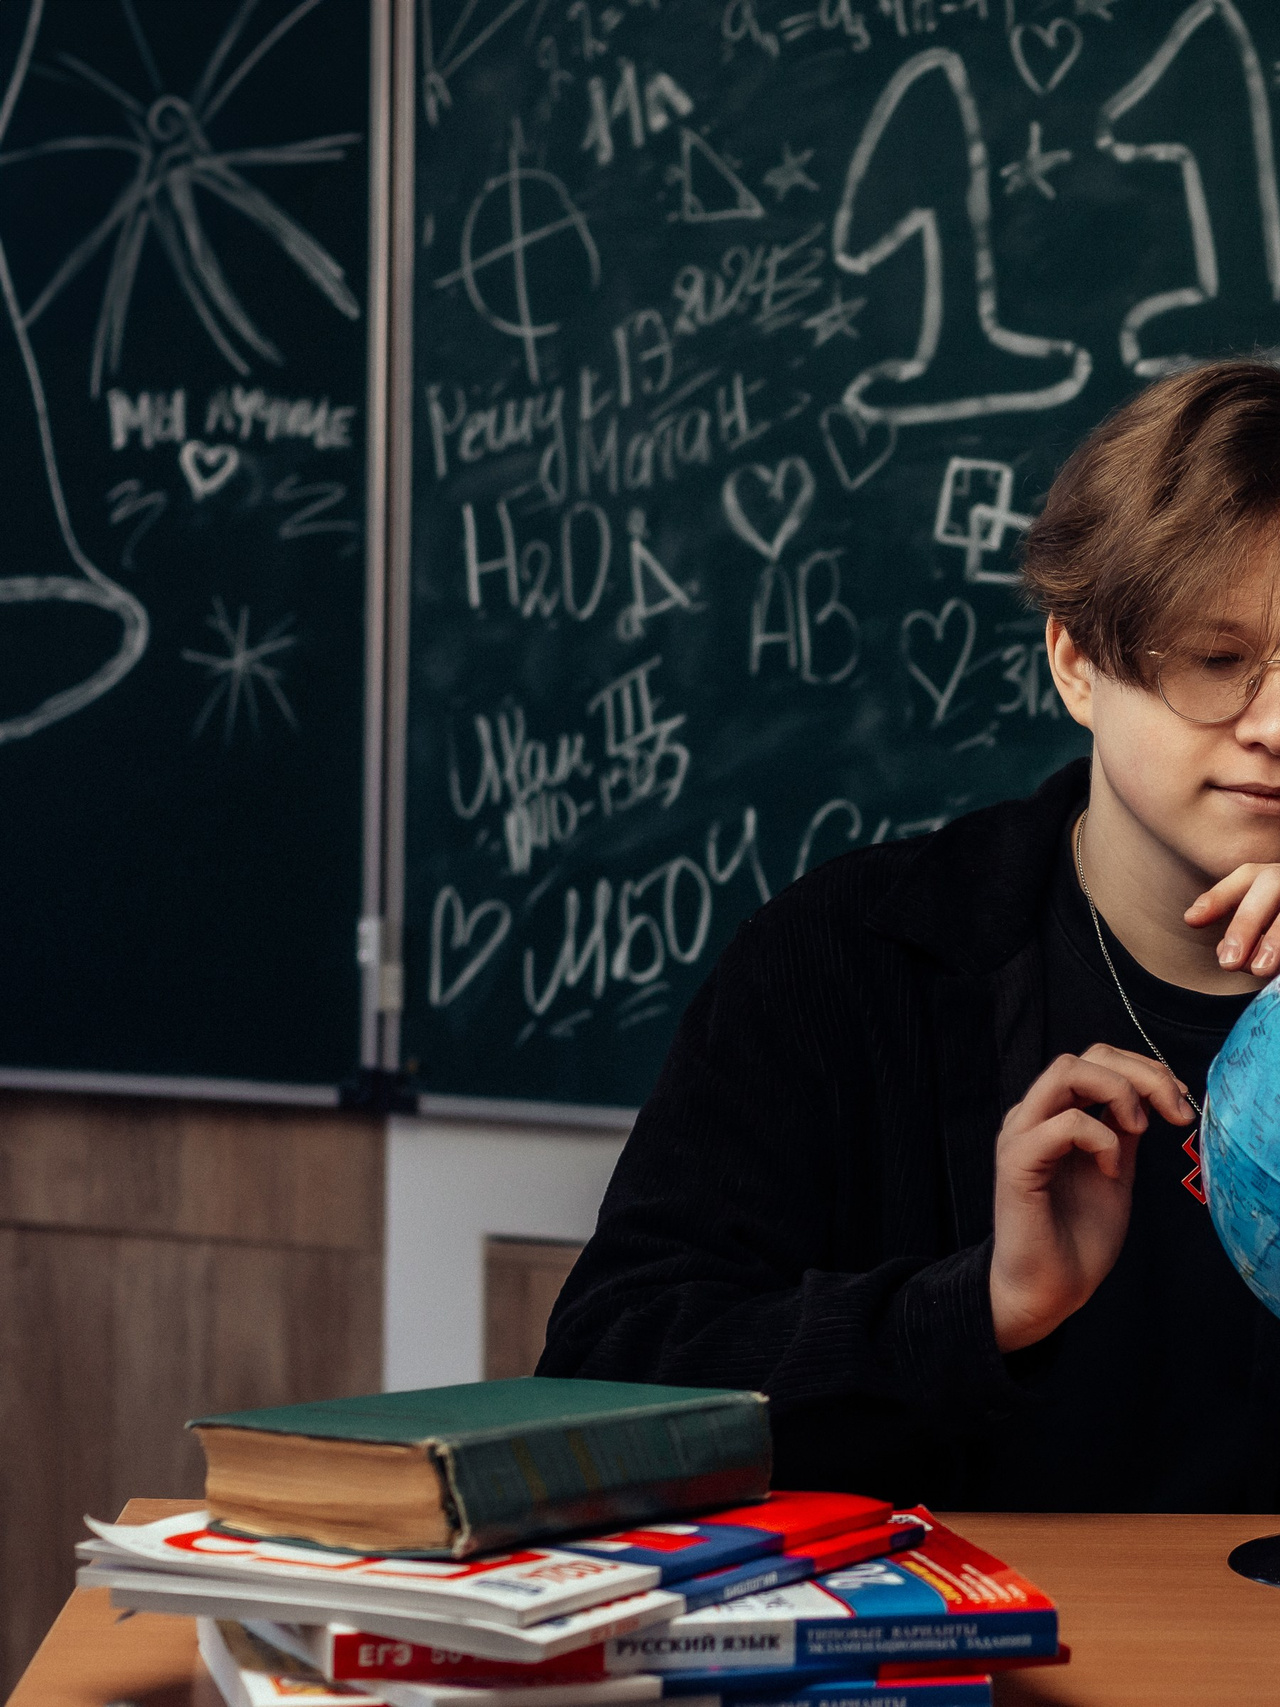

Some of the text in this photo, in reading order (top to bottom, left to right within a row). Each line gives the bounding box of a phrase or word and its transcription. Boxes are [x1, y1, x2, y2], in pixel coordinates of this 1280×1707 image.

[357, 1643, 413, 1668] ЕГЭ
[615, 1631, 781, 1657] РУССКИЙ ЯЗЫК
